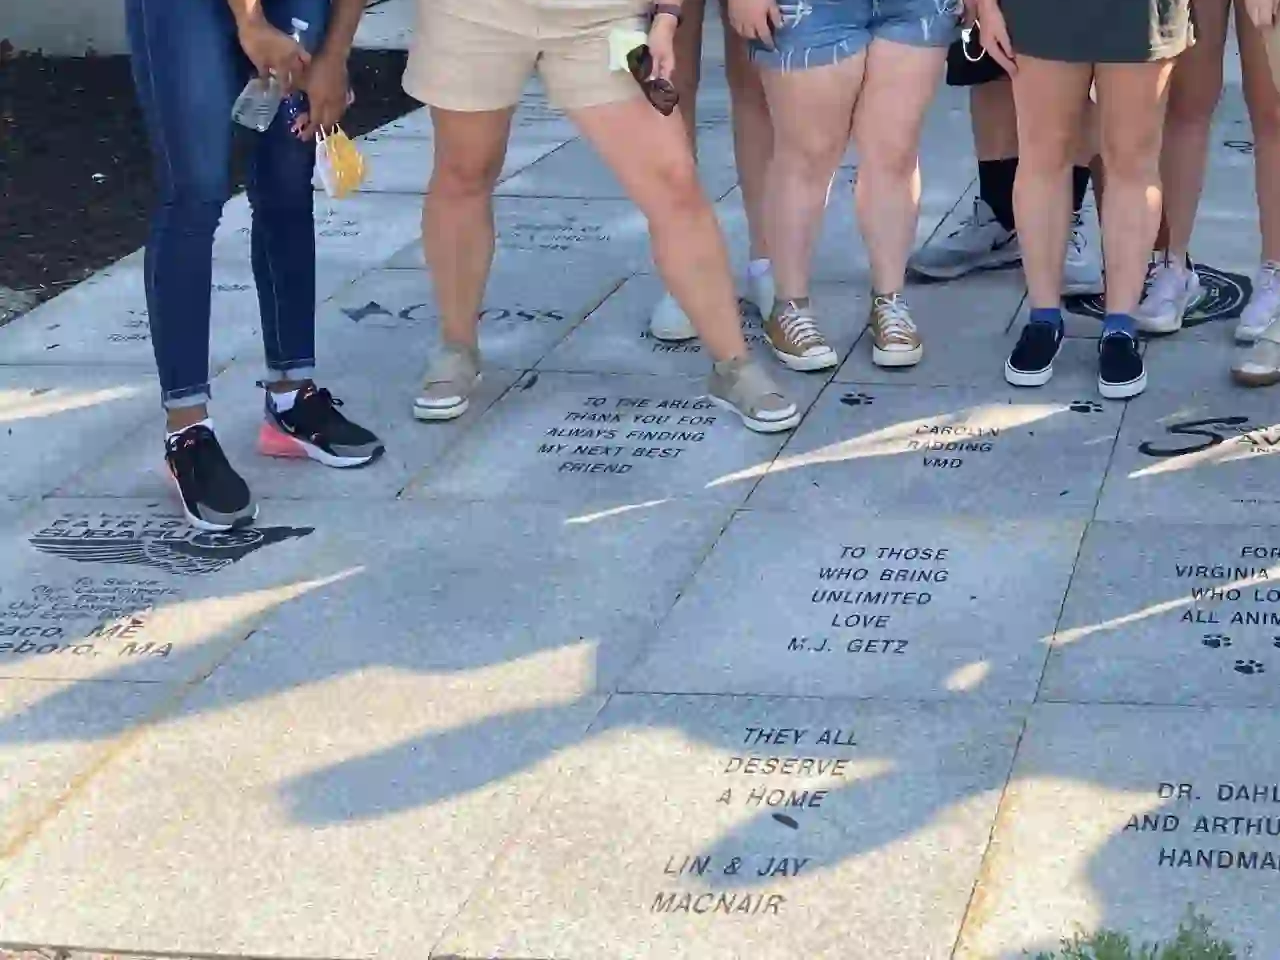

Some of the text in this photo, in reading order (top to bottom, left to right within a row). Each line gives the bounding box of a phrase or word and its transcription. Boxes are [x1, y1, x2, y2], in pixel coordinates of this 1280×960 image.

[583, 396, 606, 407] TO
[616, 396, 651, 408] THE
[564, 411, 717, 426] THANK YOU FOR
[545, 427, 706, 442] ALWAYS FINDING
[537, 443, 687, 459] MY NEXT BEST
[557, 462, 634, 475] FRIEND
[922, 457, 964, 469] VMD
[34, 528, 192, 540] SUBARU
[840, 546, 949, 561] TO THOSE
[818, 567, 950, 583] WHO BRING
[1175, 563, 1270, 580] VIRGINIA
[811, 590, 933, 605] UNLIMITED
[1191, 587, 1242, 602] WHO
[831, 613, 891, 628] LOVE
[1180, 609, 1220, 624] ALL
[0, 624, 145, 639] aco, ME
[118, 642, 173, 658] MA
[846, 639, 909, 654] GETZ
[743, 727, 858, 746] THEY ALL
[723, 756, 851, 777] DESERVE
[716, 788, 829, 808] A HOME
[1157, 782, 1201, 801] DR.
[1122, 813, 1181, 832] AND
[663, 854, 812, 877] LIN & JAY
[650, 891, 788, 915] MACNAIR
